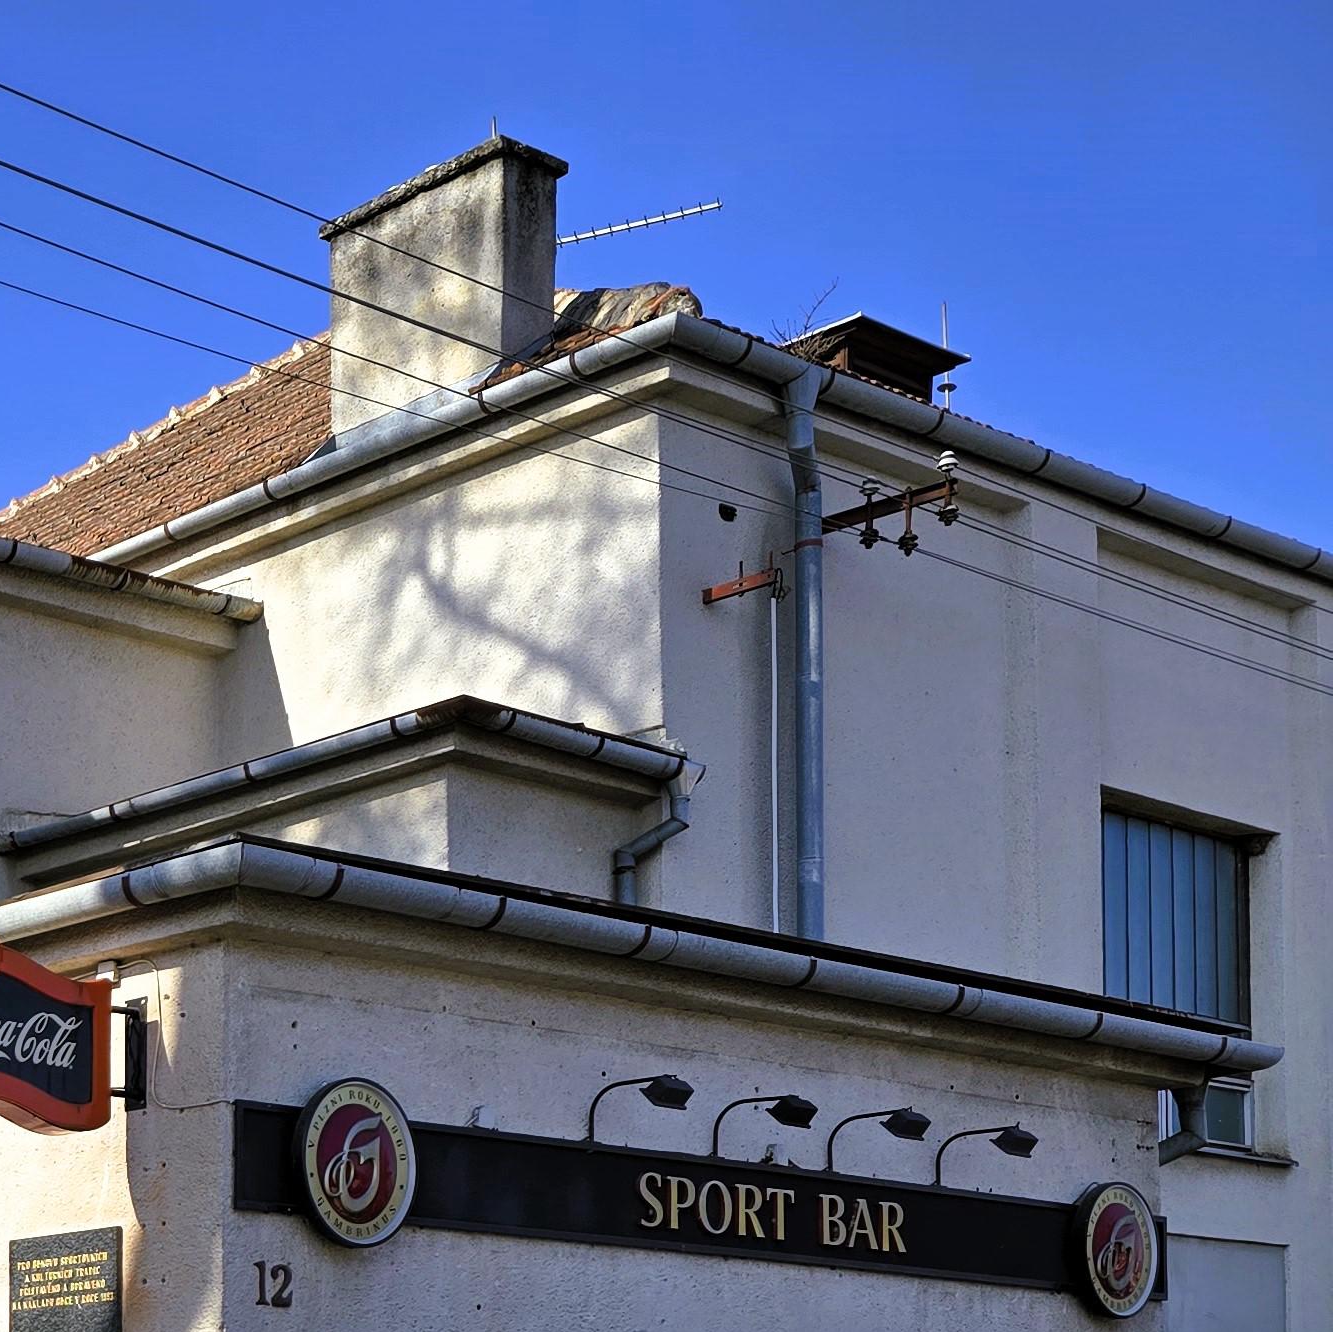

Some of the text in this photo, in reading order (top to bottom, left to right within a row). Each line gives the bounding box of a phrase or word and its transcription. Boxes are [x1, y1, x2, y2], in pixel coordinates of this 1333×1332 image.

[313, 1093, 343, 1131] PLZNI
[349, 1090, 380, 1109] ROKU
[317, 1196, 397, 1237] GAMBRINUS
[639, 1171, 907, 1253] SPORT BAR
[253, 1260, 293, 1308] 12
